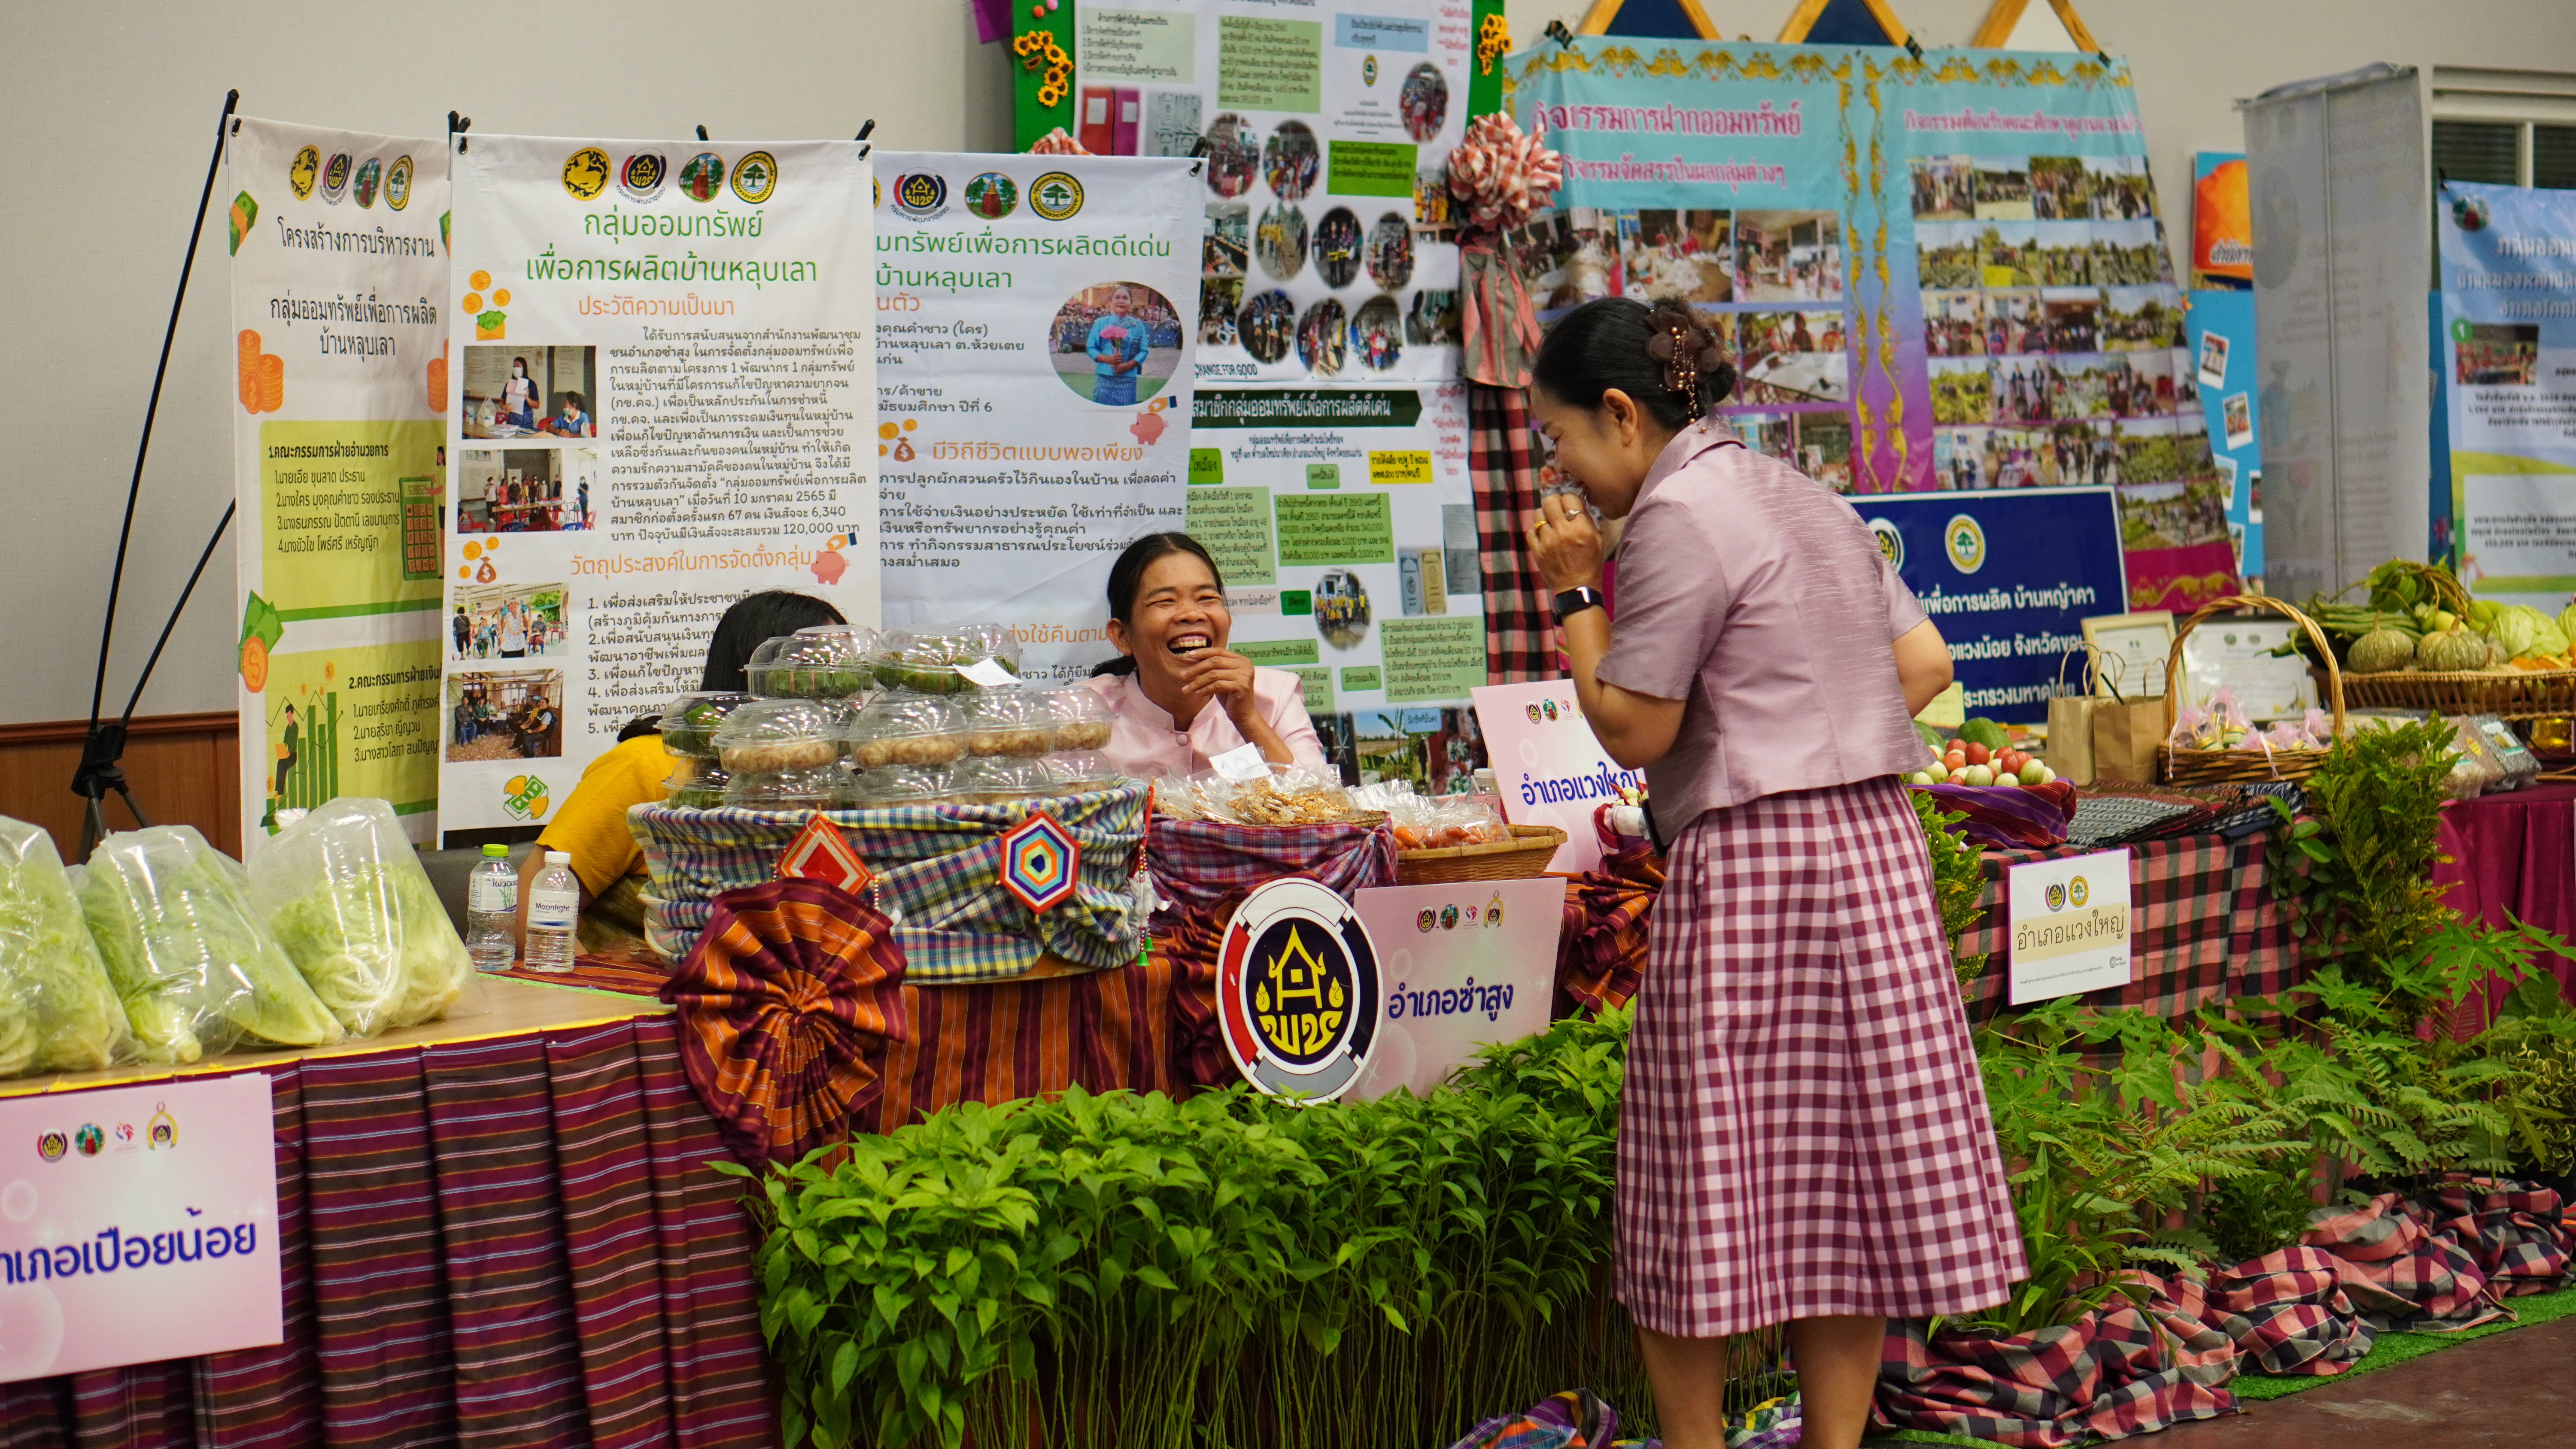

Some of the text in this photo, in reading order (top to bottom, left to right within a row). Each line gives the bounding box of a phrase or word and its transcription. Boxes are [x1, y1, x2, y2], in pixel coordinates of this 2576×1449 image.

[585, 205, 763, 244] กลุ่มออมทรัพย์
[277, 216, 434, 258] โครงสร้างการบริหารงาน
[526, 243, 817, 290] เพื่อการผลิตบ้านหลุบเลา
[876, 263, 1012, 293] บ้านหลุบเลา
[270, 286, 437, 327] กลุ่มออมทรัพย์เพื่อการผลิต
[579, 292, 735, 316] ประวัติความเป็นมา
[320, 326, 396, 362] บ้านหลุบเลา
[610, 345, 690, 361] ชนอำเภอซำสูง
[956, 339, 1024, 351] ต.ห้วยเตย
[611, 358, 854, 376] การผลิตตามโครงการ 1 พัฒนากร 1 กลุ่มทรัพย์
[1223, 364, 1236, 375] FOR
[1236, 364, 1257, 376] GOOD
[877, 384, 942, 396] าร/ค้าขาย
[611, 396, 659, 411] (กข.คจ.)
[878, 398, 993, 412] มัธยมศึกษา ปีที่ 6
[1192, 391, 1391, 424] สมาชิกกลุ่มออมทรัพย์เพื่อการผลิตดีเด่น
[611, 416, 650, 424] กข.คจ.
[269, 440, 389, 458] 1.คณะกรรมการฝ่ายอำนวยการ
[802, 439, 851, 452] ทำให้เกิด
[933, 440, 1143, 461] มีวิถีชีวิตแบบพอเพียง
[816, 455, 850, 469] จึงได้มี
[340, 468, 365, 482] ประธาน
[612, 473, 717, 491] การรวมตัวกันจัดตั้ง
[879, 469, 1176, 488] การปลูกผักสวนครัวไว้กินเองในบ้าน เพื่อลดค่า
[361, 489, 399, 504] รองประธาน
[688, 489, 730, 506] เมื่อวันที่
[734, 493, 747, 504] 10
[751, 494, 793, 503] มกราคม
[796, 491, 825, 502] 2565
[829, 489, 836, 501] มี
[879, 488, 905, 500] จ่าย
[611, 506, 846, 524] สมาชิกก่อตั้งครั้งแรก 67 คน เงินสัจจะ 6,340
[879, 502, 1182, 518] การใช้จ่ายเงินอย่างประหยัด ใช้เท่าที่จำเป็น และ
[611, 532, 635, 541] บาท
[783, 522, 833, 535] 120,000
[837, 524, 860, 533] บาท
[880, 521, 1086, 539] เงินหรือทรัพยากรอย่างรู้คุณค่า
[880, 541, 904, 550] การ
[571, 543, 811, 579] วัตถุประสงค์ในการจัดตั้งกลุ่ม
[588, 598, 598, 609] 1.
[2014, 582, 2095, 610] บ้านหญ้าคา
[589, 611, 724, 631] (สร้างภูมิคุ้มกันทางการ
[588, 669, 600, 680] 3.
[588, 687, 600, 698] 4.
[588, 717, 630, 734] 5. เพื่อ
[536, 903, 570, 912] Moonlight
[2017, 907, 2124, 950] อำเภอแวงใหญ่
[1388, 975, 1514, 1022] อำเภอซำสูง
